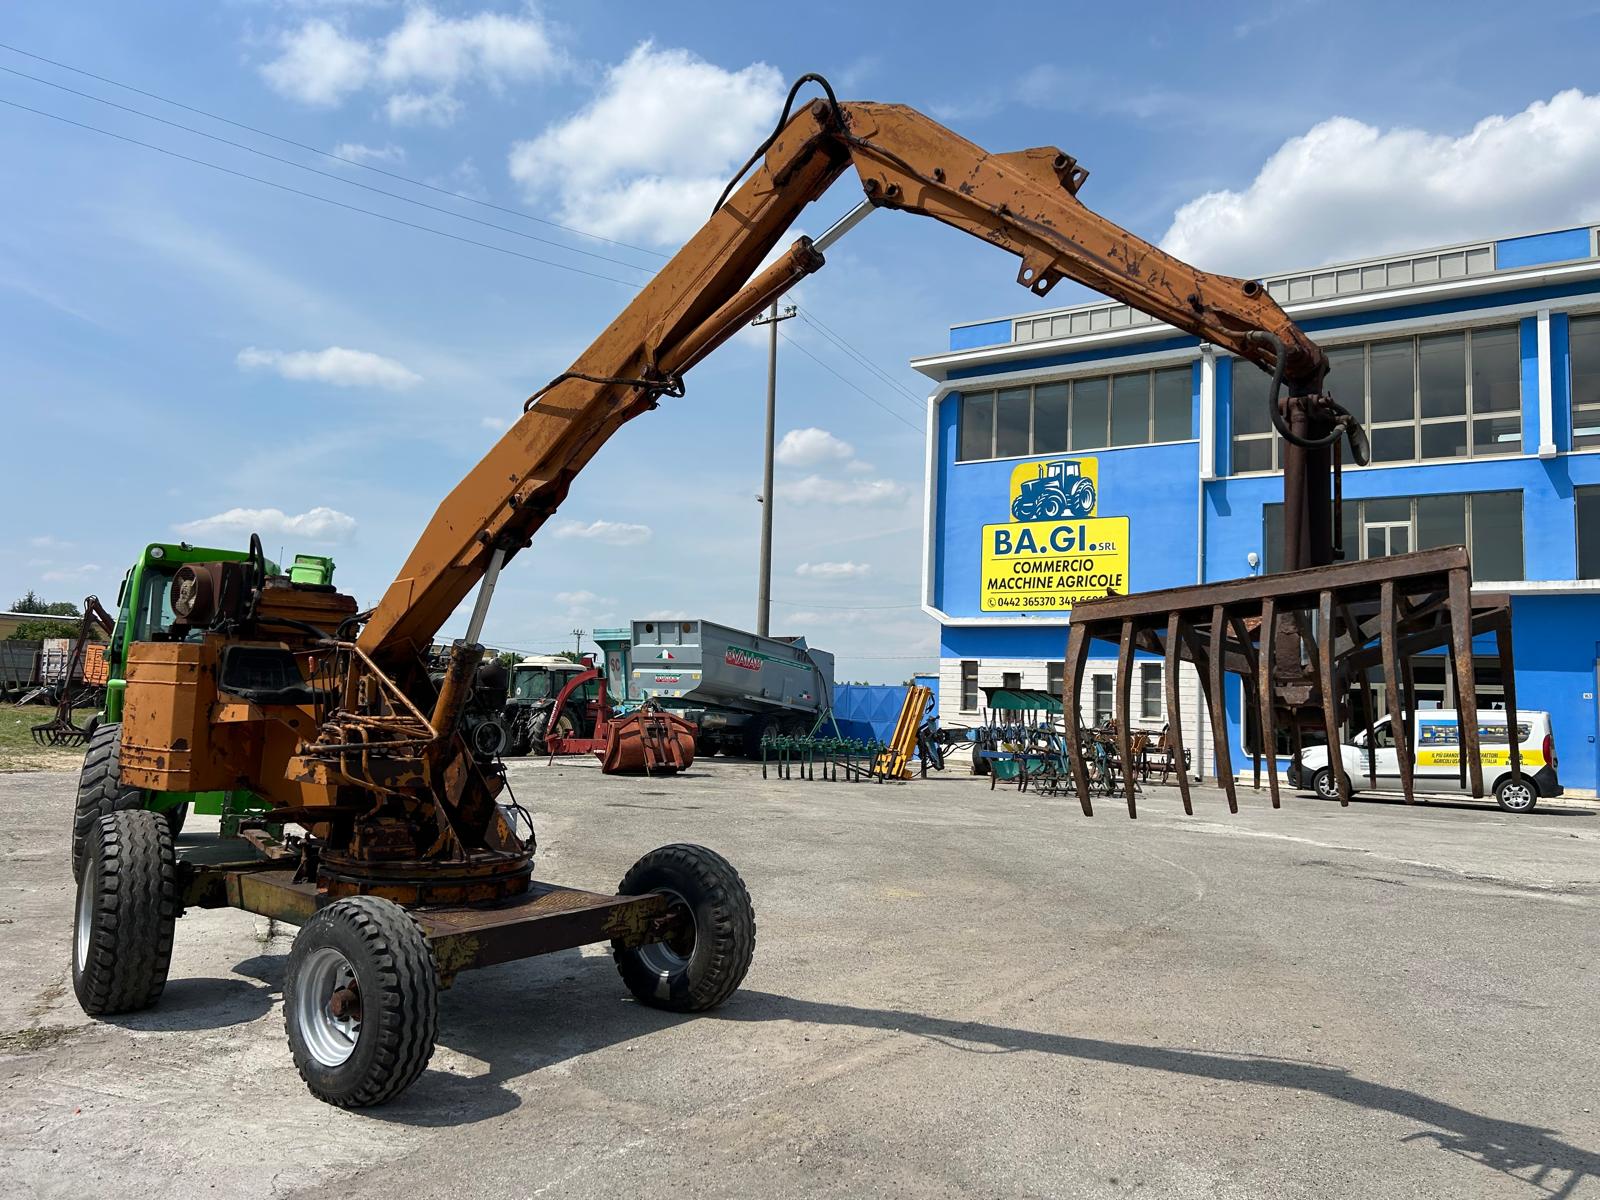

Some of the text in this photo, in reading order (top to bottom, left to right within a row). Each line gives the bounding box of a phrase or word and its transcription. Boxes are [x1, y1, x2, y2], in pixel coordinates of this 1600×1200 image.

[994, 525, 1116, 556] BA.GI. SRL
[1013, 559, 1094, 574] COMMERCIO
[987, 574, 1123, 590] MACCHINE AGRICOLE
[997, 597, 1021, 607] 0442
[1023, 596, 1056, 607] 365370
